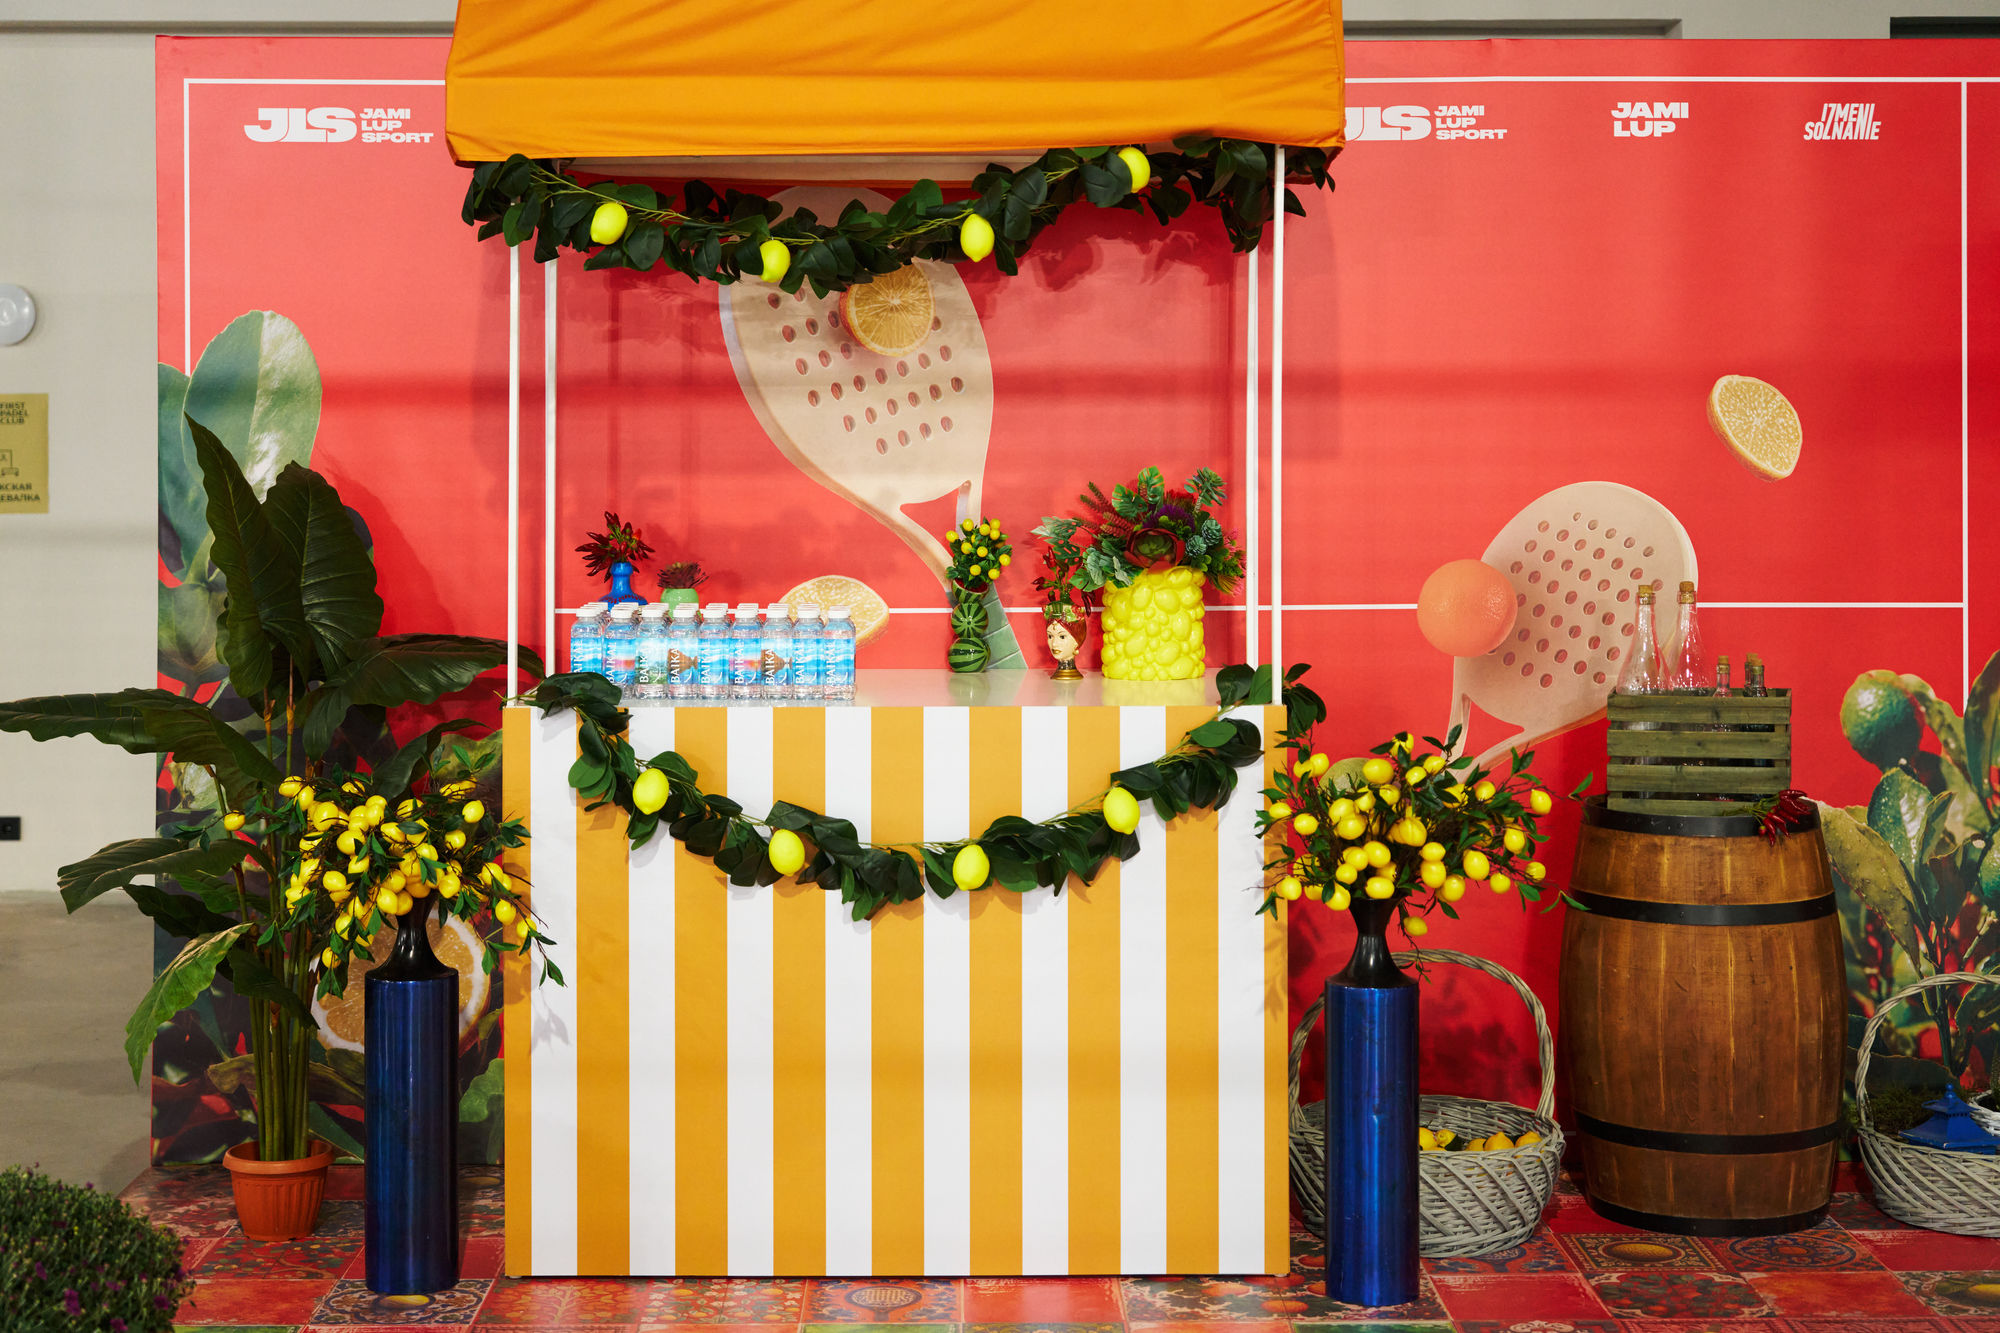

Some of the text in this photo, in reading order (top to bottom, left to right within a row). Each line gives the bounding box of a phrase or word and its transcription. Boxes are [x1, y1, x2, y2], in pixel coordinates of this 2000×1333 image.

[359, 108, 411, 119] JAMI
[1434, 105, 1485, 116] JAMI
[1611, 102, 1689, 118] JAMI
[244, 107, 357, 142] JLS
[361, 120, 402, 131] LUP
[1435, 118, 1477, 128] LUP
[1436, 129, 1508, 140] SPORT
[1613, 121, 1676, 137] LUP
[361, 132, 434, 143] SPORT
